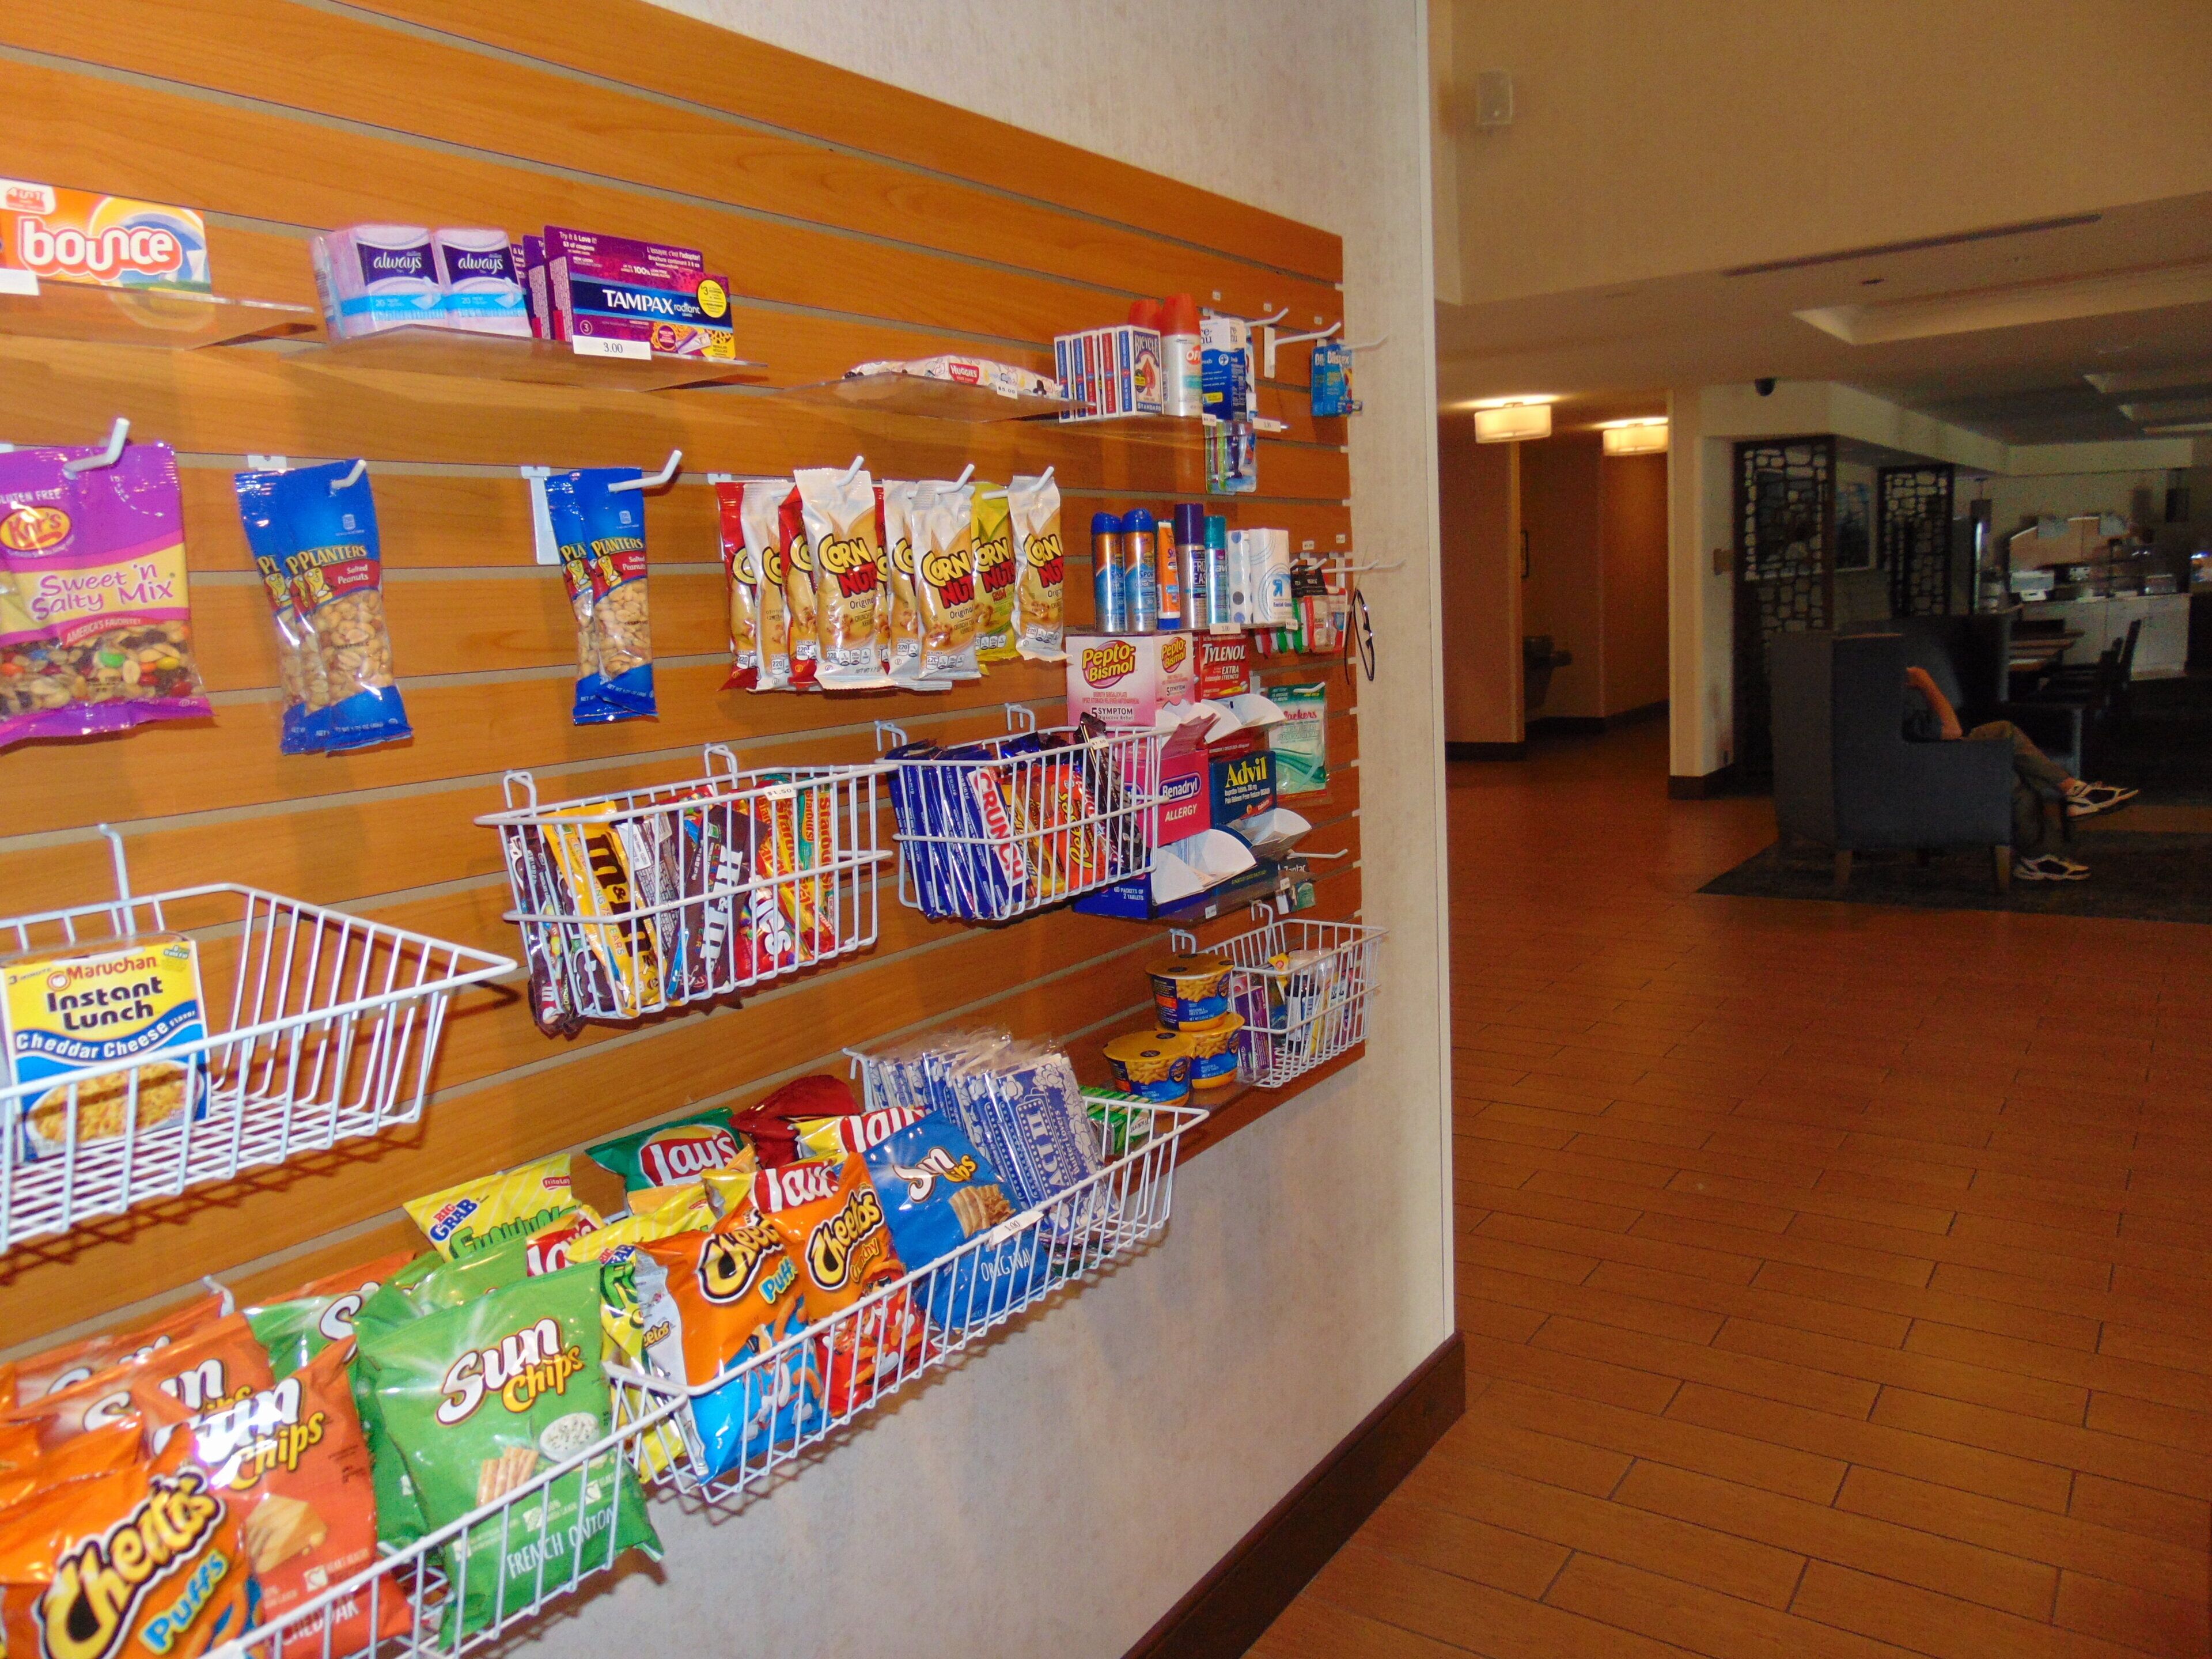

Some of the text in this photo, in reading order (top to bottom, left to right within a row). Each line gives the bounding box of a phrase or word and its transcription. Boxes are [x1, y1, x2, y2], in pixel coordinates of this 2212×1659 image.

[23, 221, 173, 271] bounce
[373, 251, 422, 274] always
[458, 257, 503, 275] always
[602, 289, 701, 315] TAMPAX radiant
[603, 342, 623, 354] 3.00
[1134, 335, 1158, 362] BICYCLE
[950, 365, 978, 378] HUGGIES
[1137, 403, 1162, 411] STANDARD
[0, 492, 33, 505] LUTEN
[297, 546, 368, 570] PLANTERS
[591, 537, 644, 558] PLANTERS
[817, 533, 876, 575] CORN
[972, 537, 1010, 573] CORN
[1024, 533, 1062, 567] CORN
[338, 574, 369, 585] Peanuts
[347, 565, 368, 574] Salted
[922, 550, 974, 588] CORN
[1037, 556, 1063, 589] NUT
[39, 571, 128, 597] Sweet
[938, 573, 975, 609] NUT
[31, 581, 173, 621] Salty Mix
[850, 596, 876, 609] Origina
[949, 604, 974, 620] Original
[66, 623, 105, 640] AMERICA'S
[1082, 643, 1135, 670] Pepto-
[1162, 637, 1186, 658] Pepto-
[1164, 647, 1185, 669] Bismol
[1202, 643, 1246, 665] TYLENOL
[1088, 656, 1134, 682] Bismol
[1221, 665, 1239, 675] EXTRA
[1166, 687, 1171, 696] 5
[1092, 707, 1097, 718] 5
[1225, 756, 1268, 789] Advil
[767, 788, 792, 796] $1.50
[1162, 778, 1198, 797] Benadryl
[975, 772, 1024, 881] CRUNCH
[1165, 804, 1198, 823] ALLERGY
[818, 797, 834, 890] Starbust
[609, 927, 625, 956] EARS
[65, 956, 157, 980] Maruchan
[47, 976, 164, 1013] Instant
[63, 1000, 154, 1031] Lunch
[16, 1009, 196, 1059] Cheddar Cheese Flavor
[1055, 1110, 1081, 1176] Butter Lovers
[649, 1134, 740, 1187] Lay's
[1036, 1143, 1066, 1186] ACT
[430, 1199, 478, 1241] GRAB
[434, 1203, 456, 1222] BIG
[810, 1189, 881, 1285] Cheetos
[1004, 1220, 1021, 1232] 1.00
[980, 1247, 1032, 1282] ORIGINA
[644, 1323, 671, 1347] eetos
[437, 1318, 560, 1425] Sun
[503, 1346, 585, 1412] Chips
[232, 1411, 325, 1490] Chips
[506, 1532, 565, 1580] FRENCH
